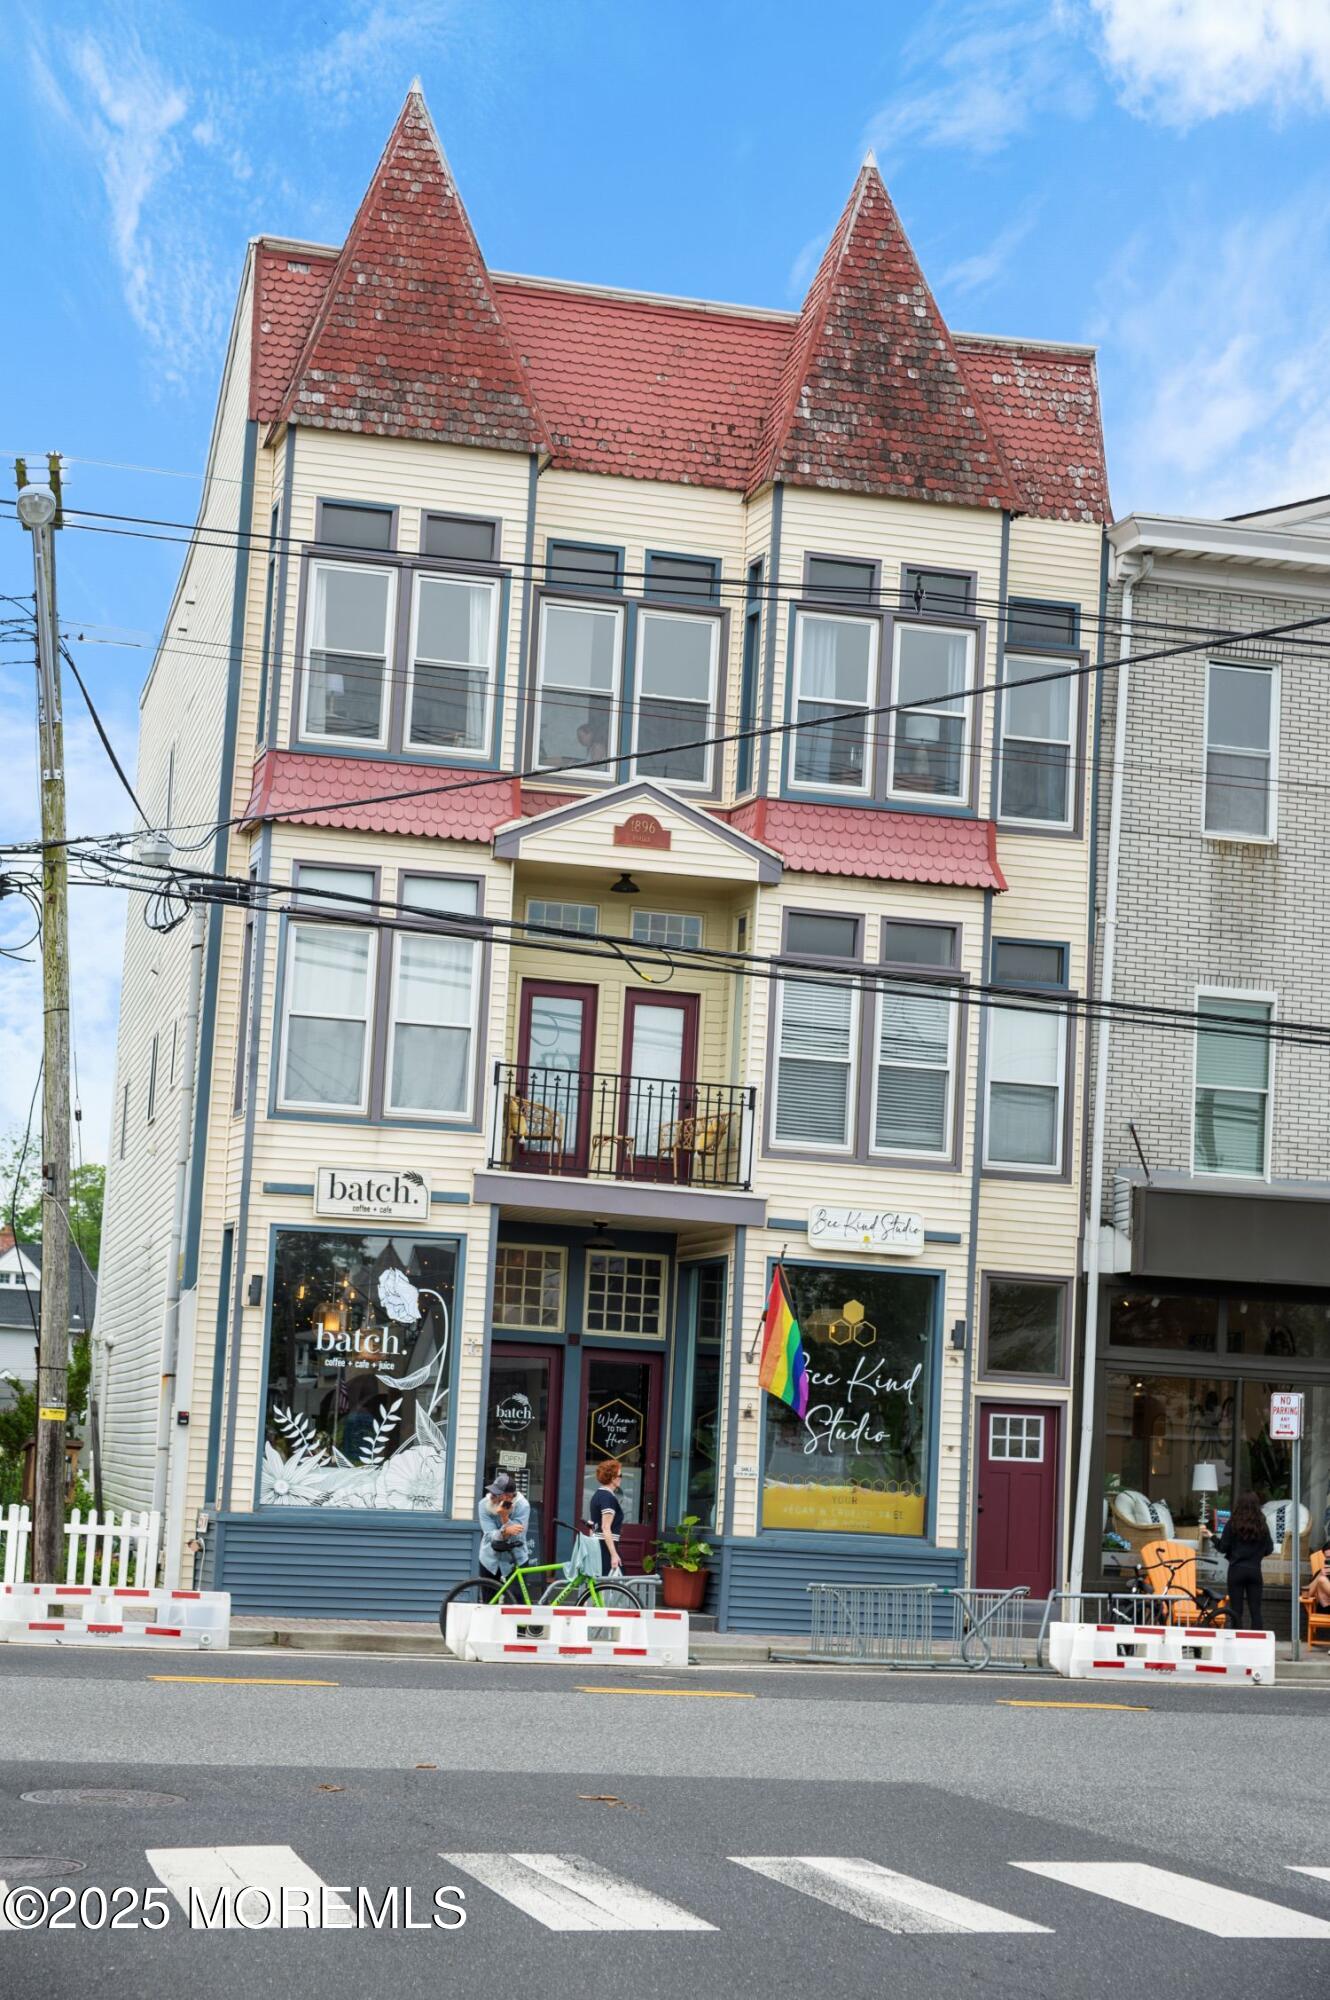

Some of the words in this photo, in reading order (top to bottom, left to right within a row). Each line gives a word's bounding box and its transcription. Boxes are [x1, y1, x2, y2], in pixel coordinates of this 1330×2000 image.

[631, 820, 656, 834] 1896
[328, 1173, 418, 1204] batch.
[352, 1204, 371, 1213] coffee
[379, 1206, 392, 1214] cafe
[811, 1208, 840, 1235] Bee
[843, 1211, 879, 1238] Kind
[881, 1213, 920, 1240] Studio
[314, 1322, 407, 1355] batch.
[324, 1357, 345, 1367] coffee
[355, 1359, 370, 1369] cafe
[378, 1360, 395, 1371] juice
[847, 1356, 922, 1405] Kind
[1280, 1396, 1291, 1405] NO
[496, 1404, 535, 1419] batch.
[1273, 1406, 1297, 1415] PARKING
[597, 1411, 637, 1428] Welcome
[803, 1404, 891, 1455] Studio
